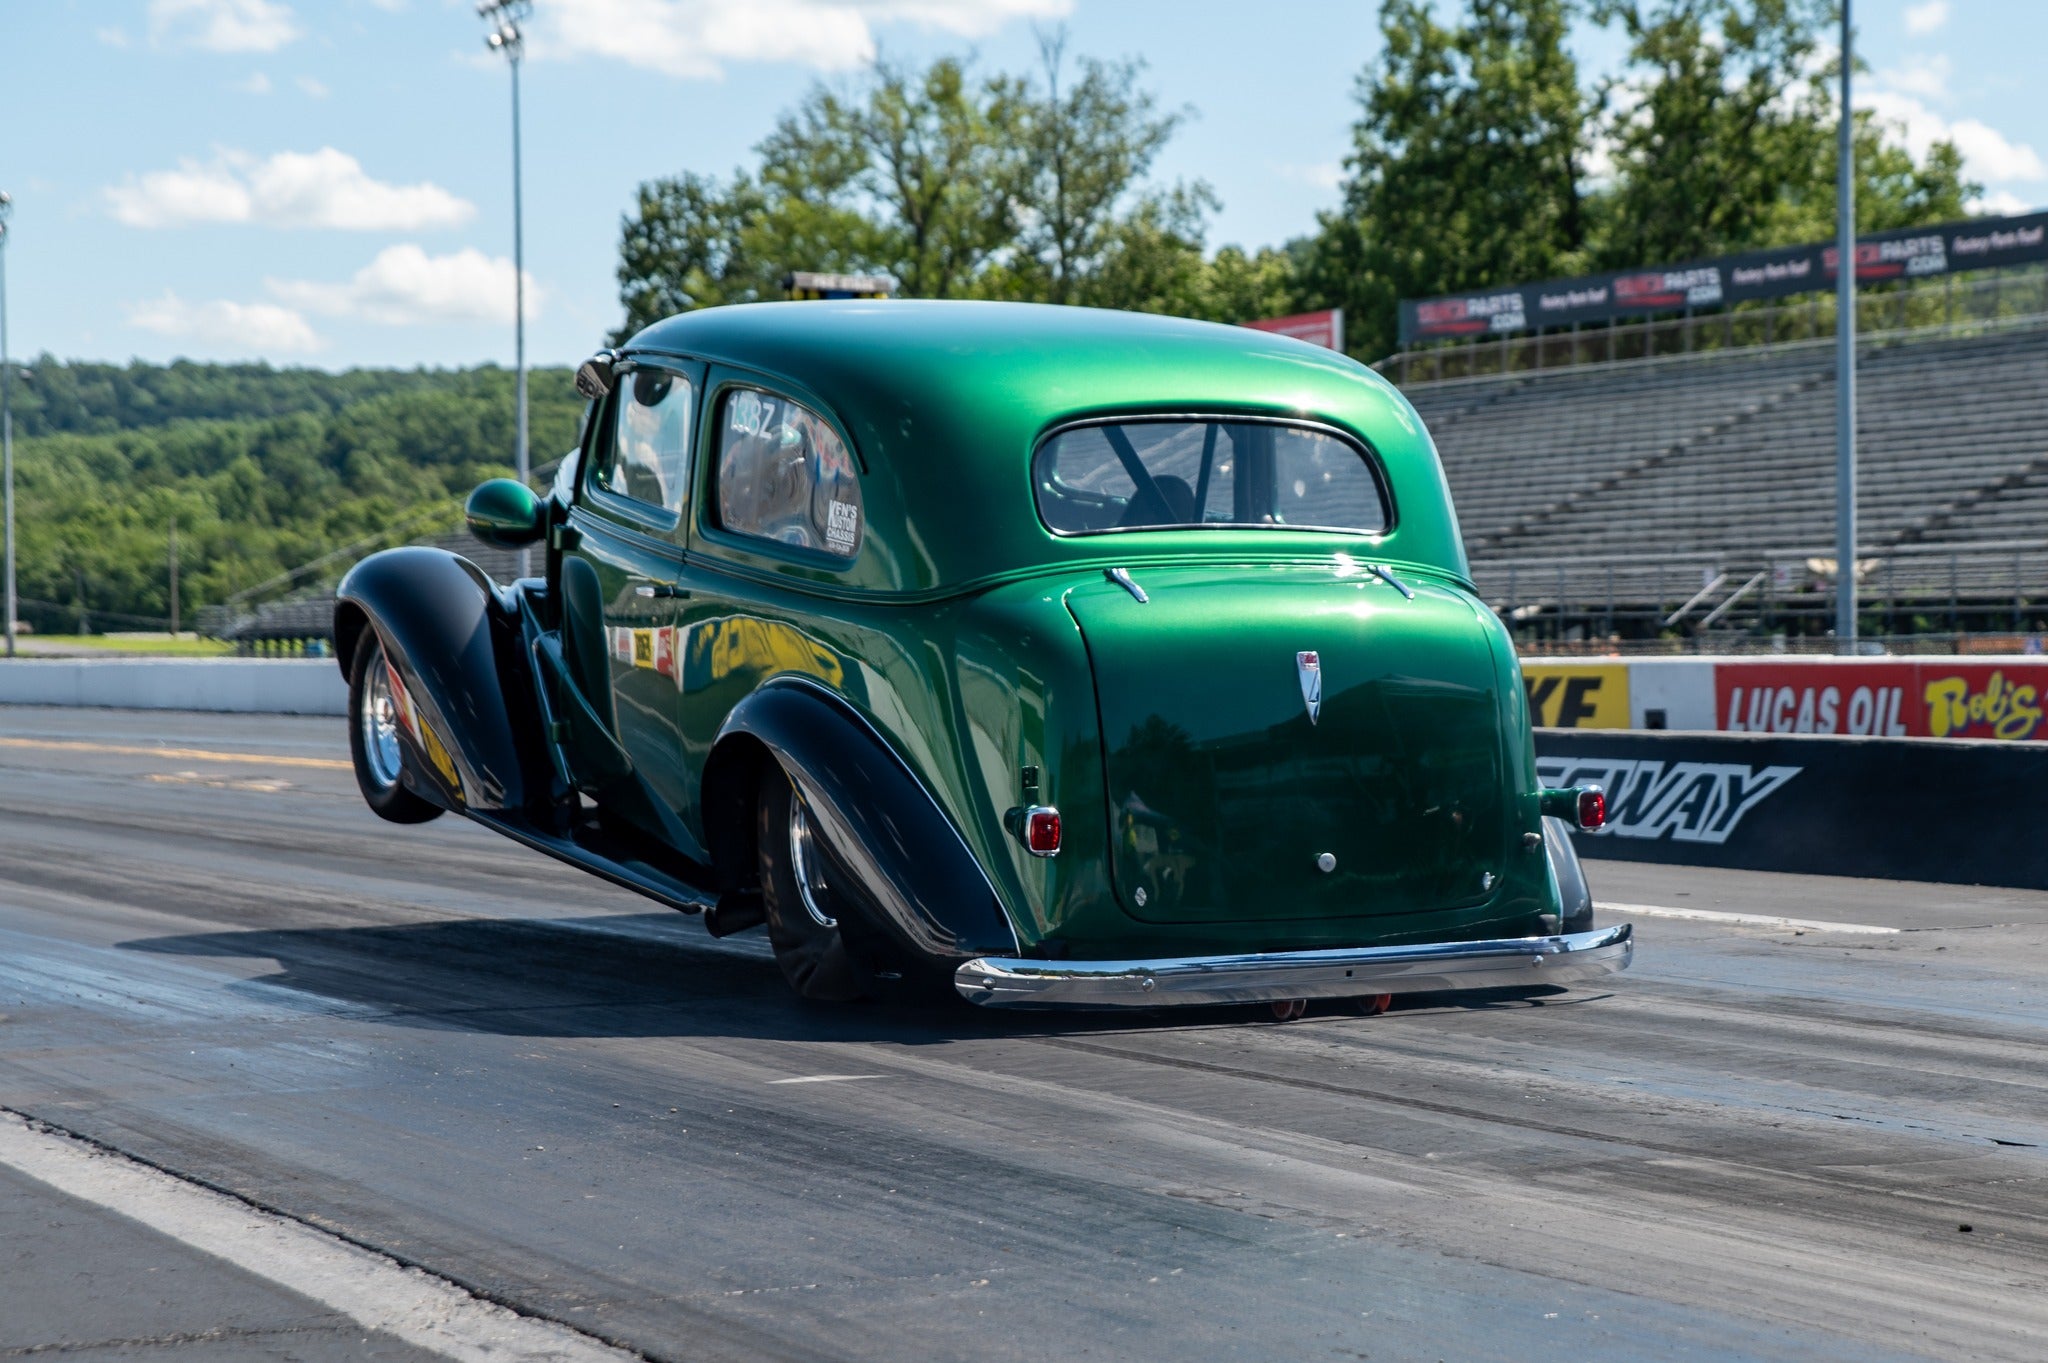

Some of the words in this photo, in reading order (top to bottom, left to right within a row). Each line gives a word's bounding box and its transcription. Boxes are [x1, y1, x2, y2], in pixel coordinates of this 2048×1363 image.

[826, 526, 855, 543] CHASSIS
[1727, 685, 1841, 735] LUCAS
[1847, 685, 1907, 737] OIL
